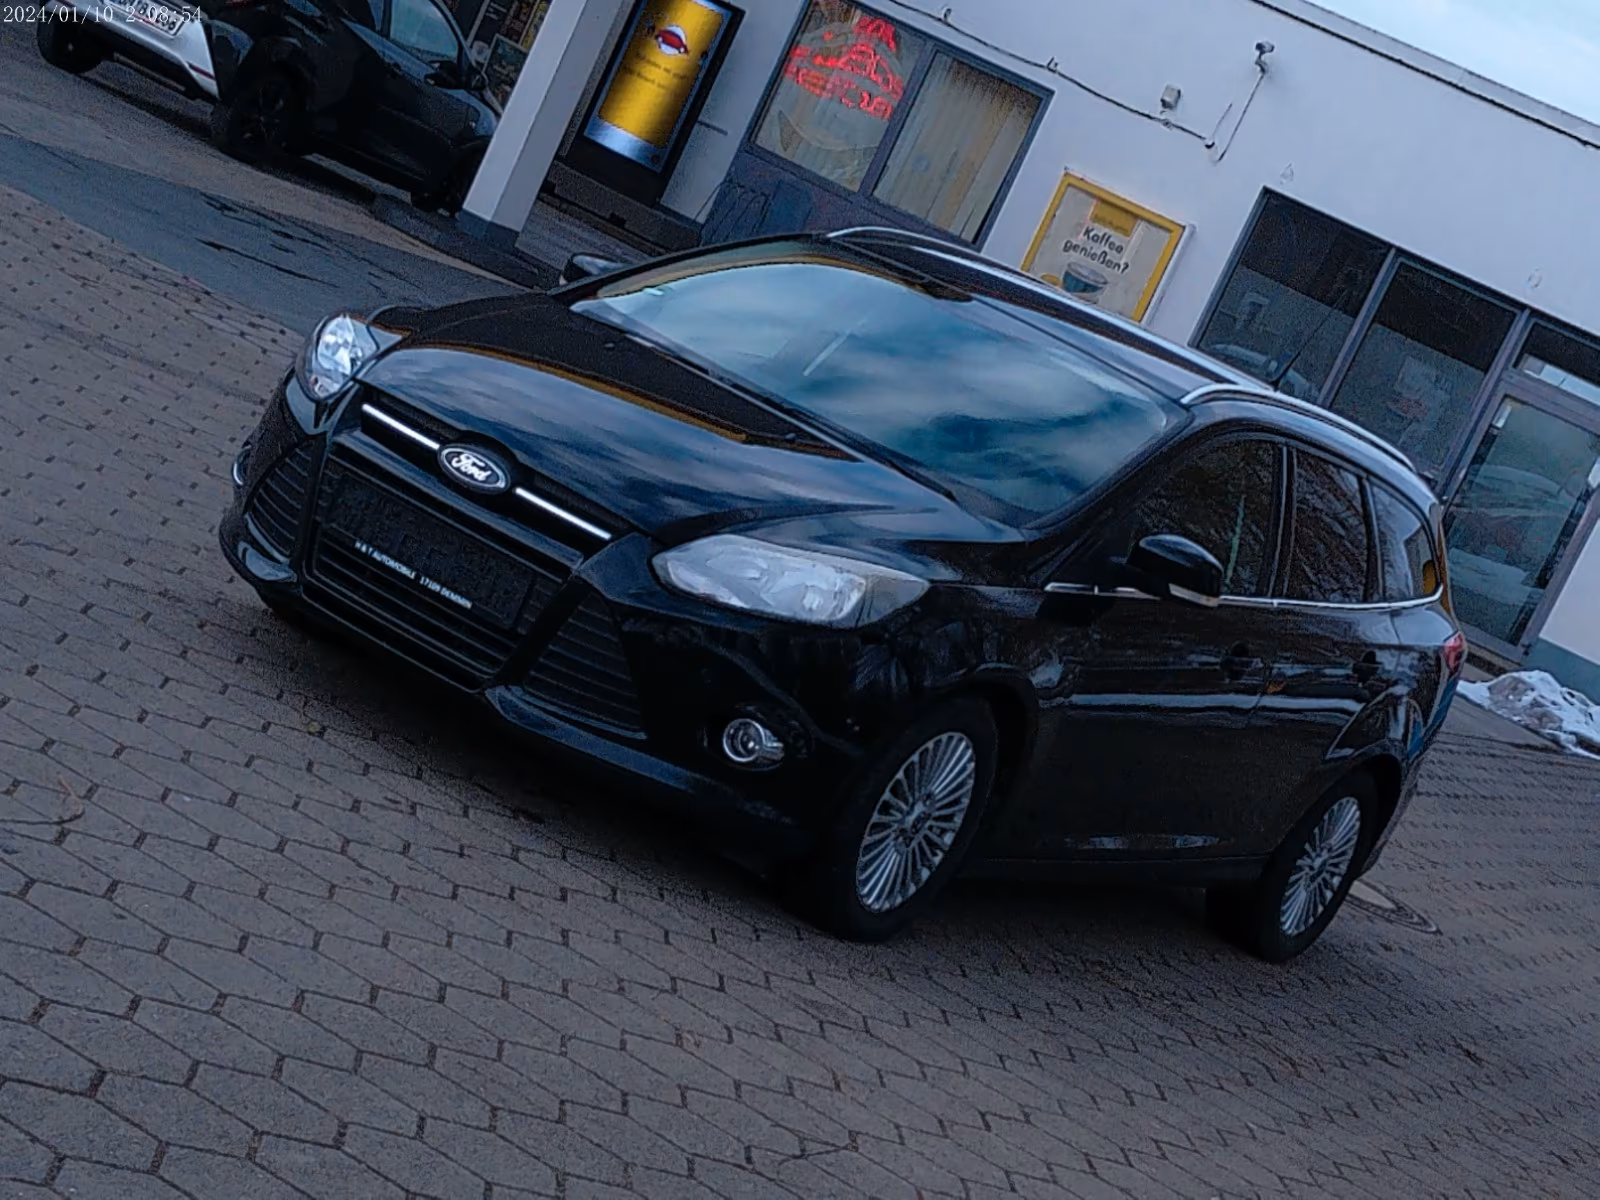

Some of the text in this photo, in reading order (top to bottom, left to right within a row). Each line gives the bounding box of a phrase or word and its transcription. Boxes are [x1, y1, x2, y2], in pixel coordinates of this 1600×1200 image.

[1083, 226, 1124, 254] Kaffee
[1062, 239, 1130, 275] genießen?
[451, 453, 492, 481] Ford
